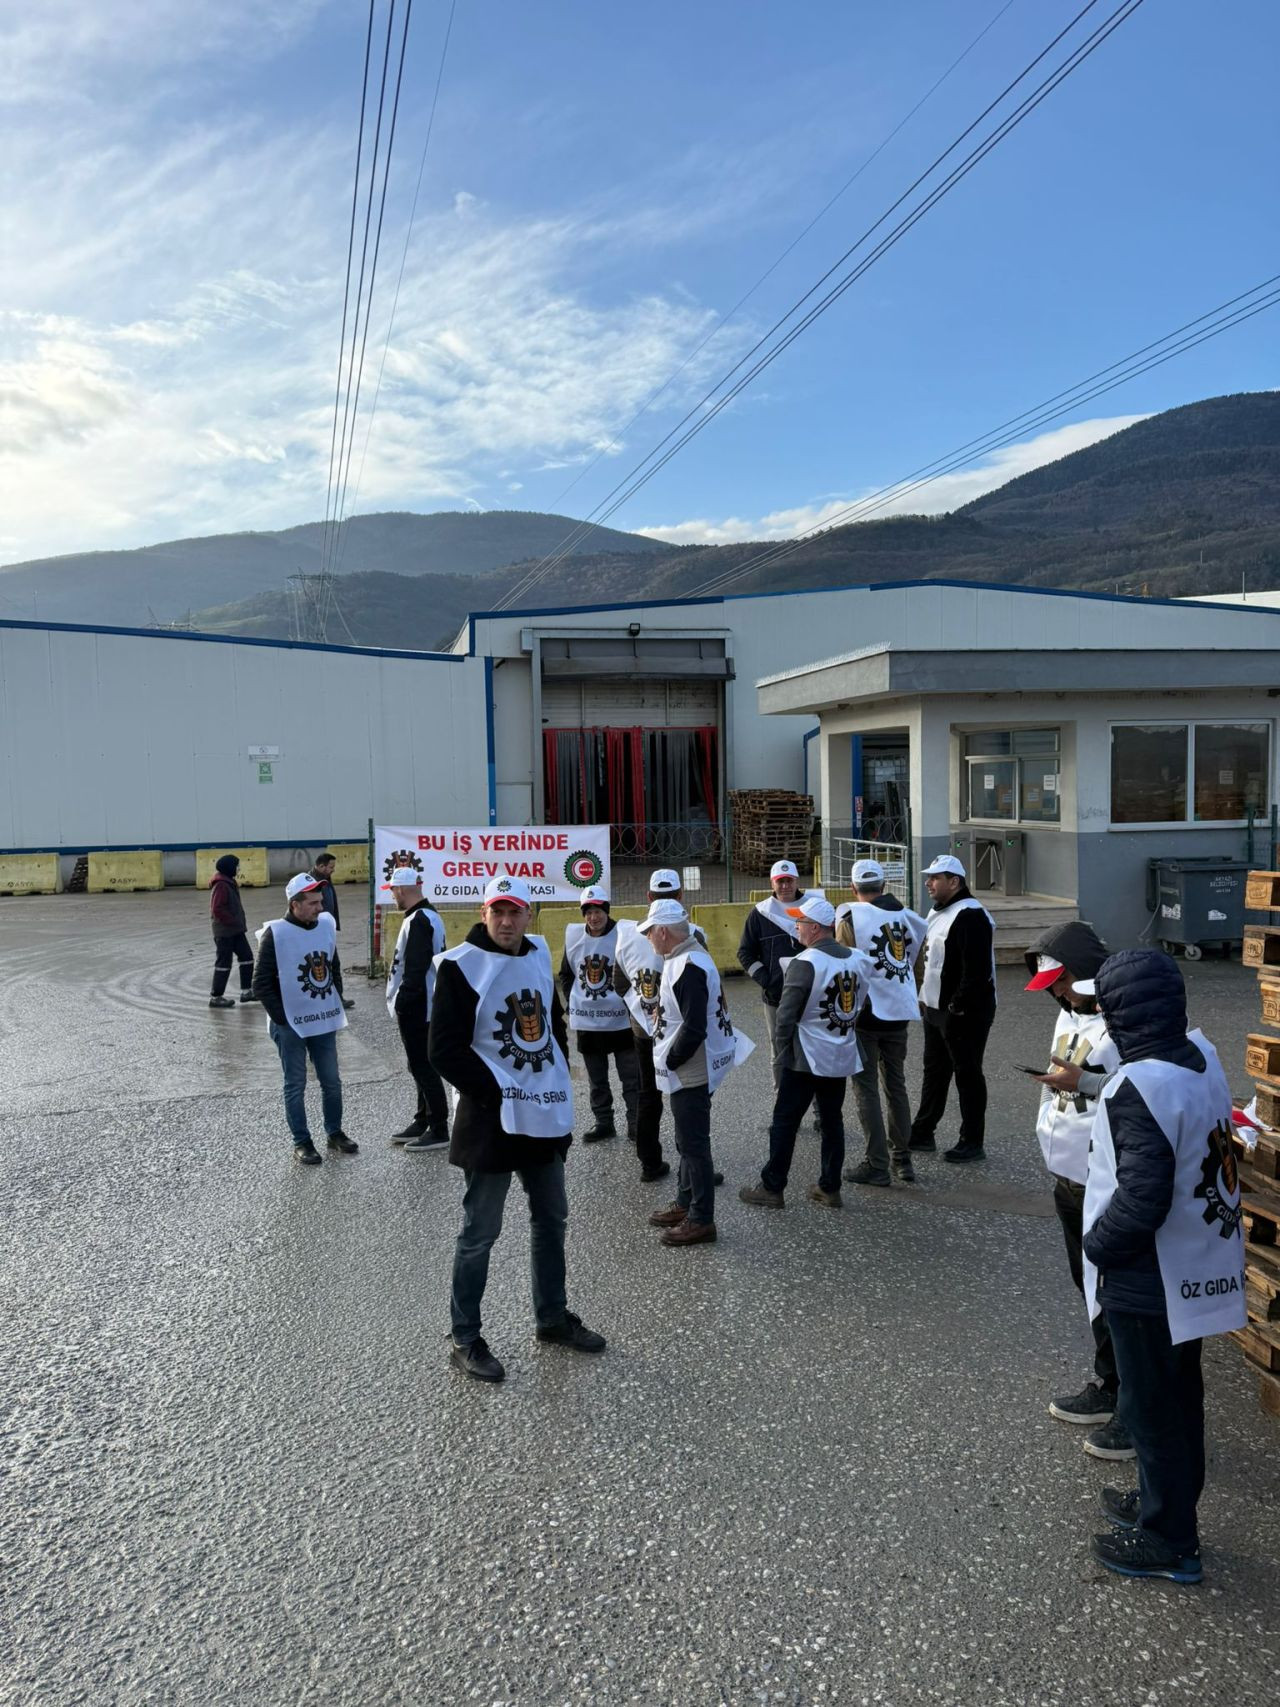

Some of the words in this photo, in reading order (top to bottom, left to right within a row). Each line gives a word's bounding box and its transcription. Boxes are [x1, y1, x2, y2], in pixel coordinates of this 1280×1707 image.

[418, 835, 446, 851] BU
[453, 831, 473, 855] İŞ
[479, 831, 569, 851] YERİNDE
[442, 861, 499, 877] GREV
[504, 862, 546, 878] VAR
[434, 884, 449, 896] ÖZ
[452, 885, 480, 896] GIDA
[1180, 1279, 1202, 1299] ÖZ
[1205, 1275, 1239, 1297] GIDA
